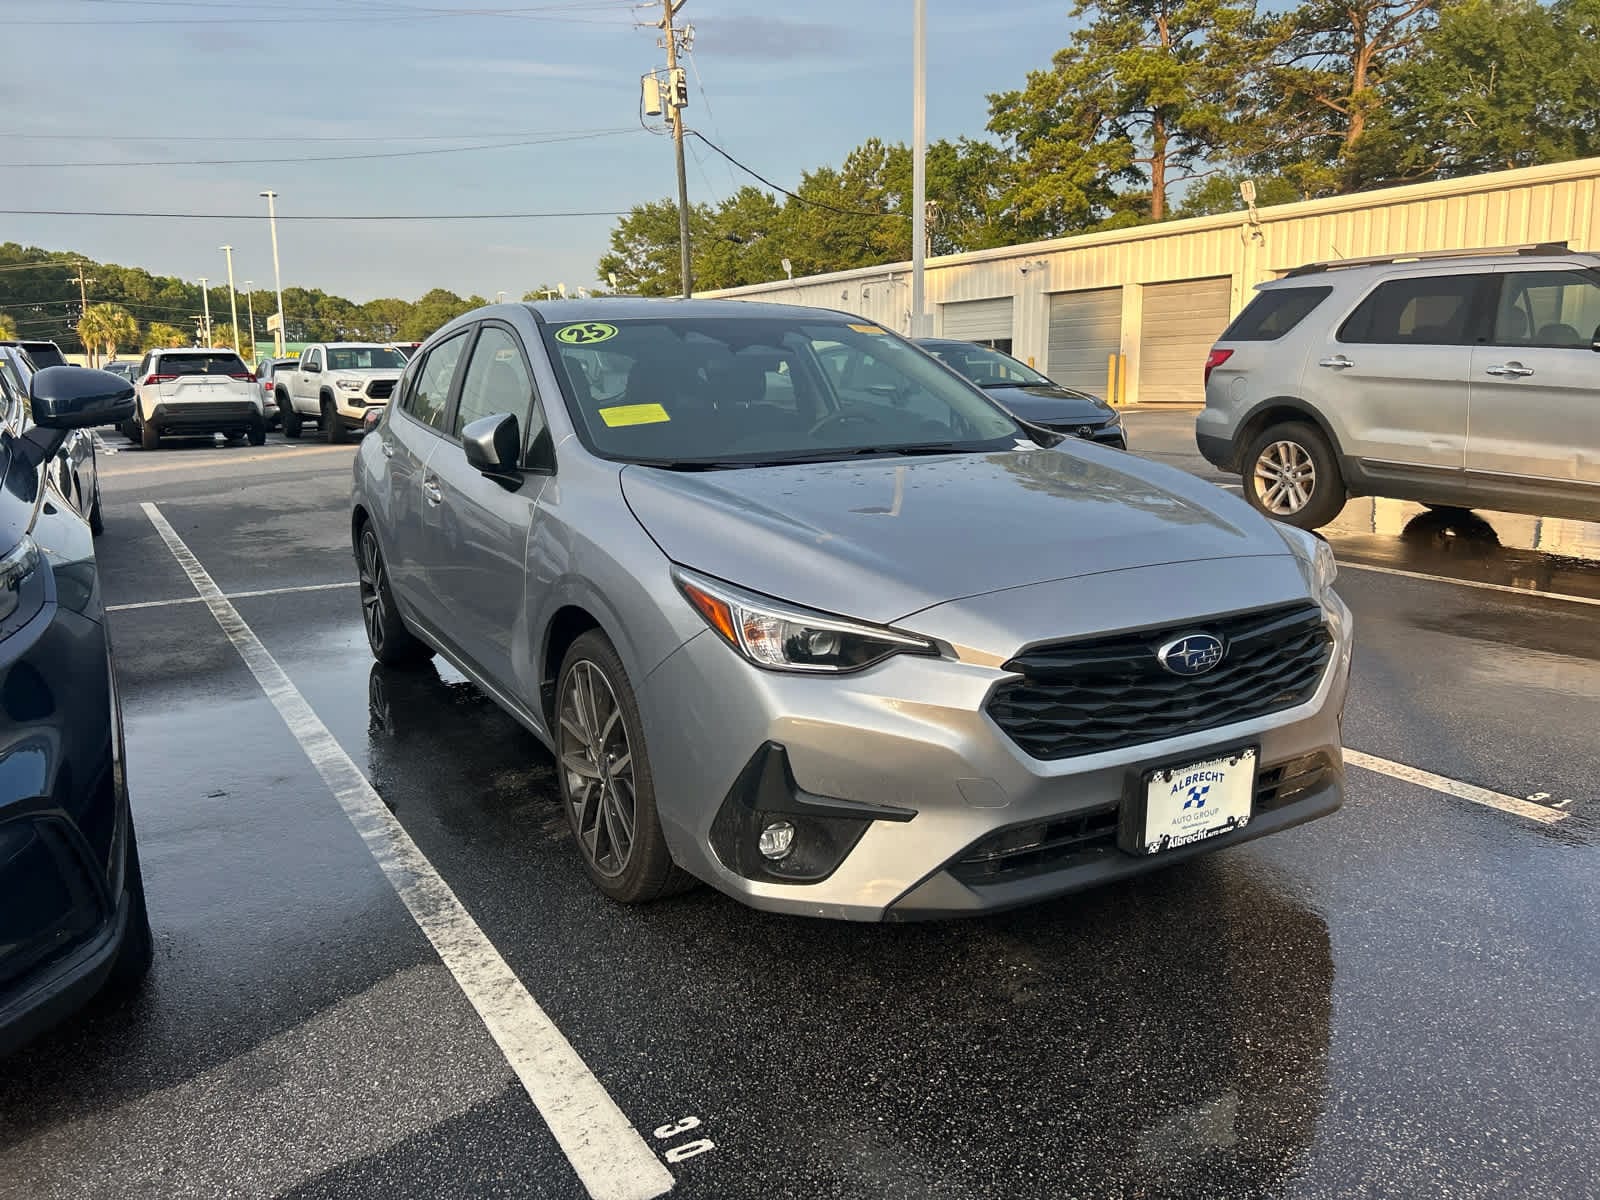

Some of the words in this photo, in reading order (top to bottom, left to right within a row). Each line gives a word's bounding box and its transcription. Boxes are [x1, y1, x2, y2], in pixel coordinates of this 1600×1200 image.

[566, 324, 606, 342] 25
[1170, 771, 1225, 795] ALBRECHT
[1171, 814, 1192, 825] AUTO
[1193, 808, 1220, 820] GROUP
[1167, 828, 1208, 849] Albrecht
[653, 1115, 716, 1164] 30
